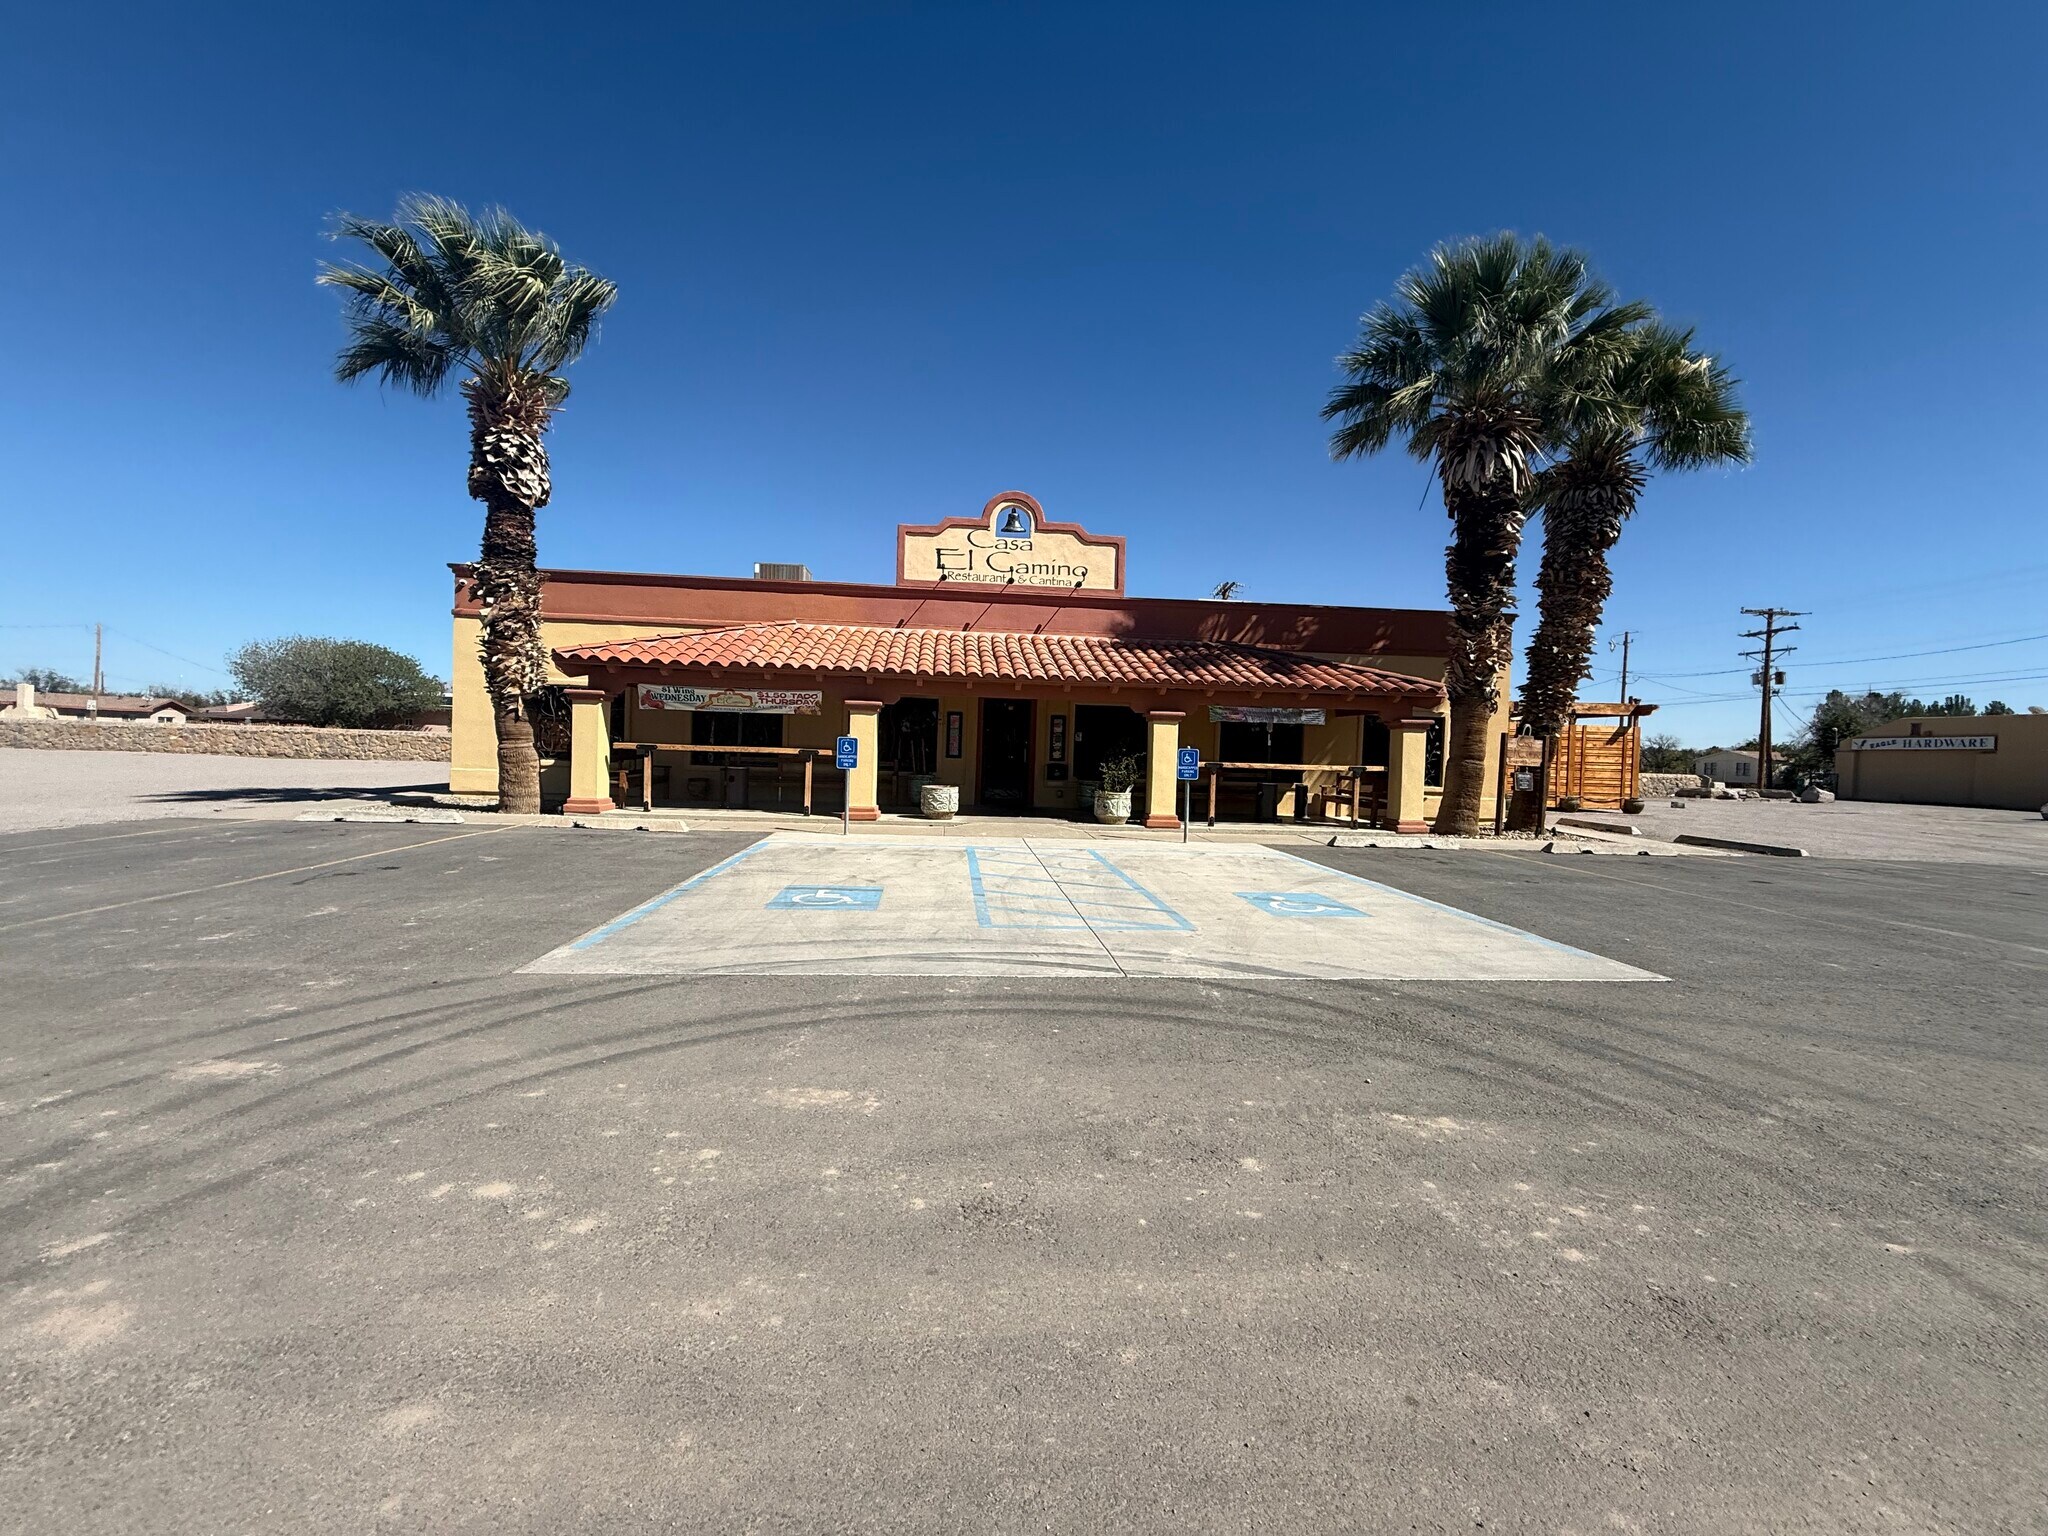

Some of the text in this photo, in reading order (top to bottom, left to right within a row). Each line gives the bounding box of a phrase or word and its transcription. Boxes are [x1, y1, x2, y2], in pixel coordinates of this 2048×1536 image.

[967, 529, 1033, 552] Casa
[935, 548, 1089, 577] El Camino
[947, 570, 1072, 587] Restaurant & Cantina
[673, 686, 695, 695] Wing
[791, 692, 818, 700] TACO
[650, 692, 706, 702] WEDNESDAY
[759, 698, 815, 706] THURSDAY
[1870, 737, 1989, 749] EAGLE HARDWARE
